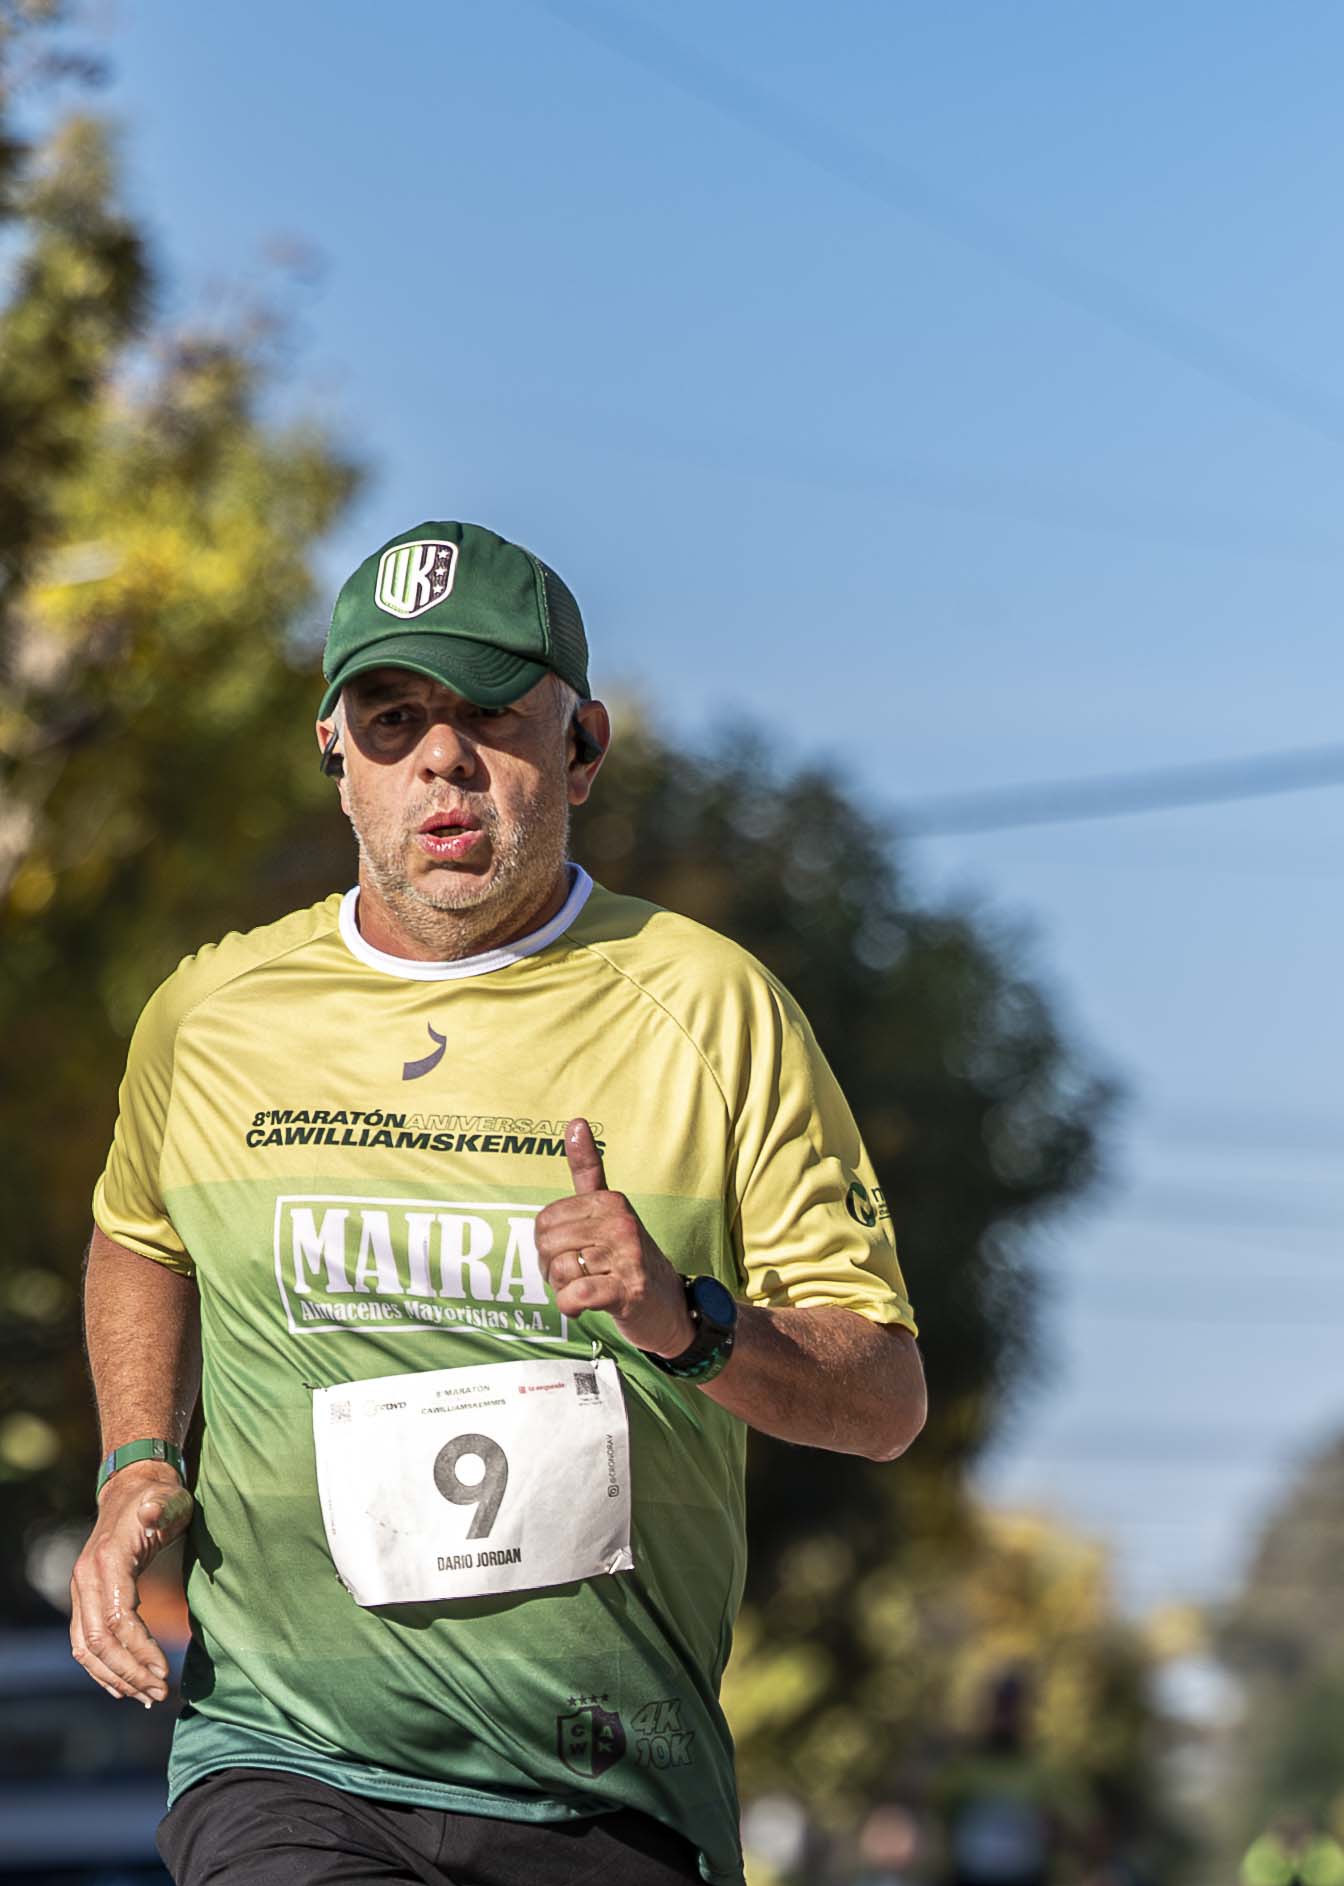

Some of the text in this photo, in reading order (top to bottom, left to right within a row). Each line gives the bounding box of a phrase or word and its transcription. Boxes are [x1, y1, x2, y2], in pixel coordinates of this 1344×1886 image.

[246, 1126, 606, 1158] CAWILLIAMSKEMMS
[405, 1114, 604, 1138] ANIVERSAO
[289, 1207, 549, 1305] MAIRA
[302, 1300, 550, 1331] Almacenes Mayoristas S.A.
[433, 1433, 509, 1540] 9
[437, 1548, 522, 1572] DARIO JORDAN
[632, 1699, 682, 1735] 4K
[636, 1732, 696, 1769] 10K
